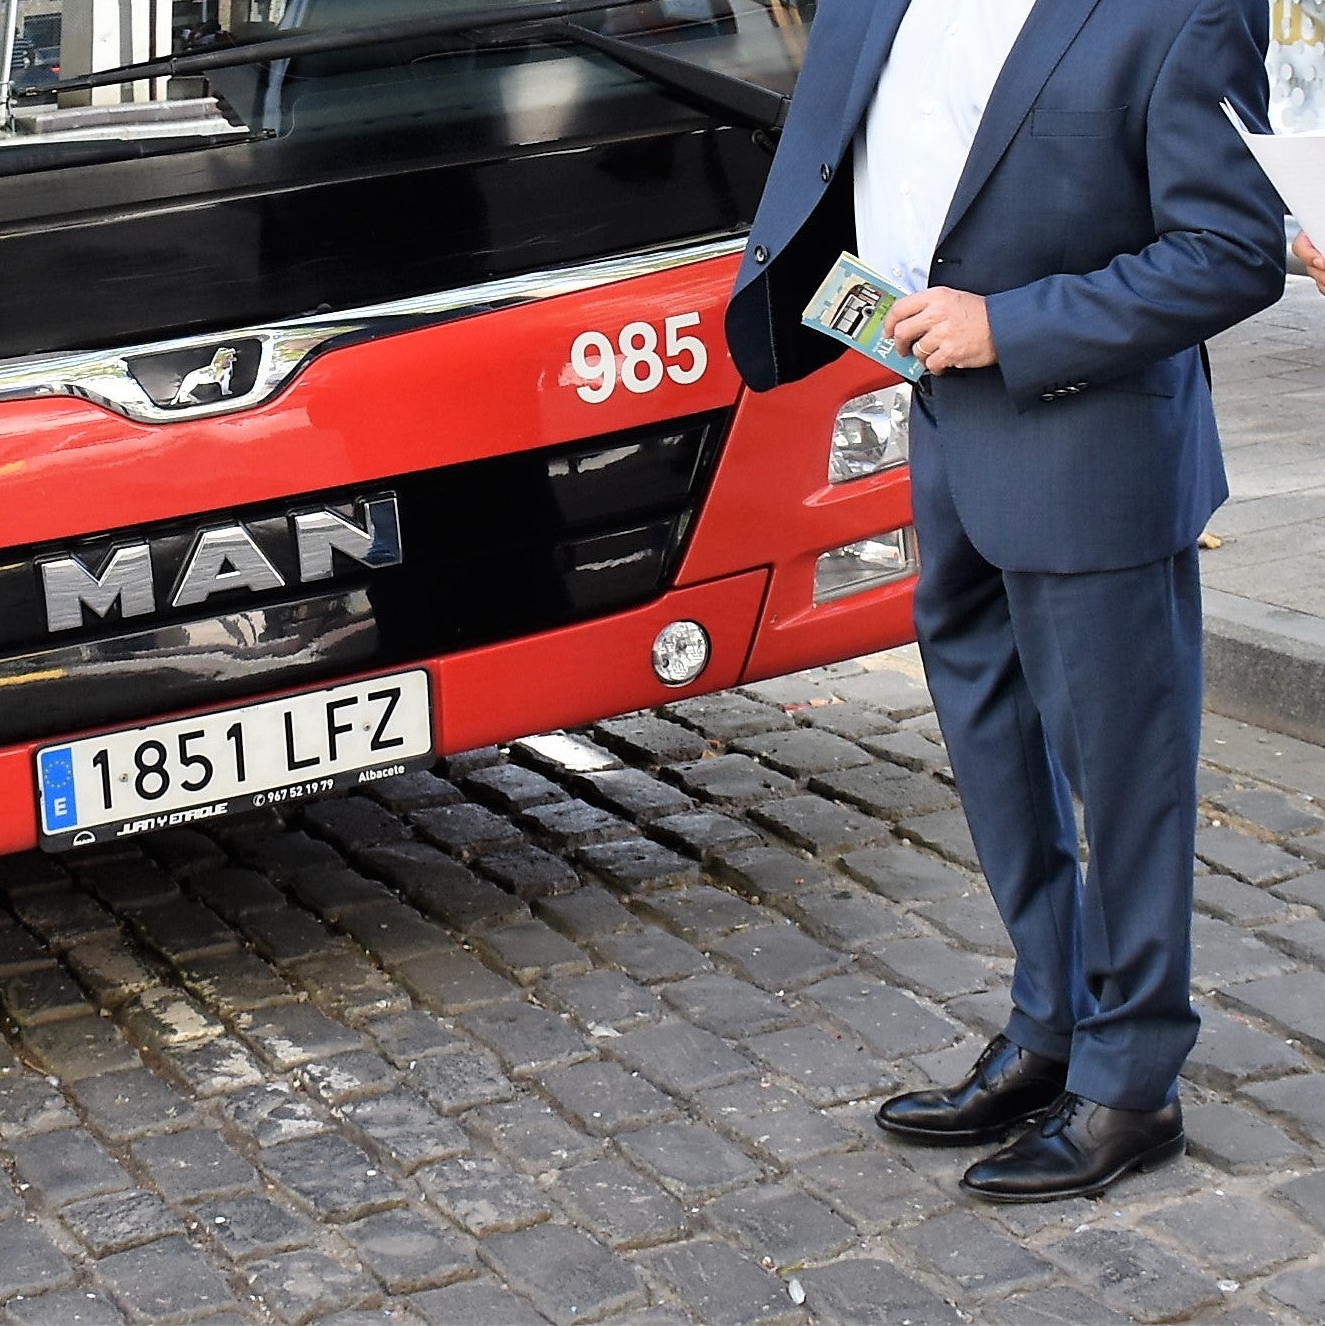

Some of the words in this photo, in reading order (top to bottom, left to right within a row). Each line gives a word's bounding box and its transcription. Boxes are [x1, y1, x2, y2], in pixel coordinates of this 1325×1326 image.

[569, 310, 709, 405] 985
[38, 492, 403, 633] MAN
[92, 721, 246, 811] 1851
[283, 686, 404, 772] LFZ
[358, 764, 406, 784] Albacete
[267, 786, 289, 804] 967
[289, 783, 305, 800] 52
[306, 780, 319, 796] 19
[320, 777, 334, 793] 79
[53, 797, 68, 817] E
[116, 816, 156, 837] JUAN
[157, 813, 169, 830] Y
